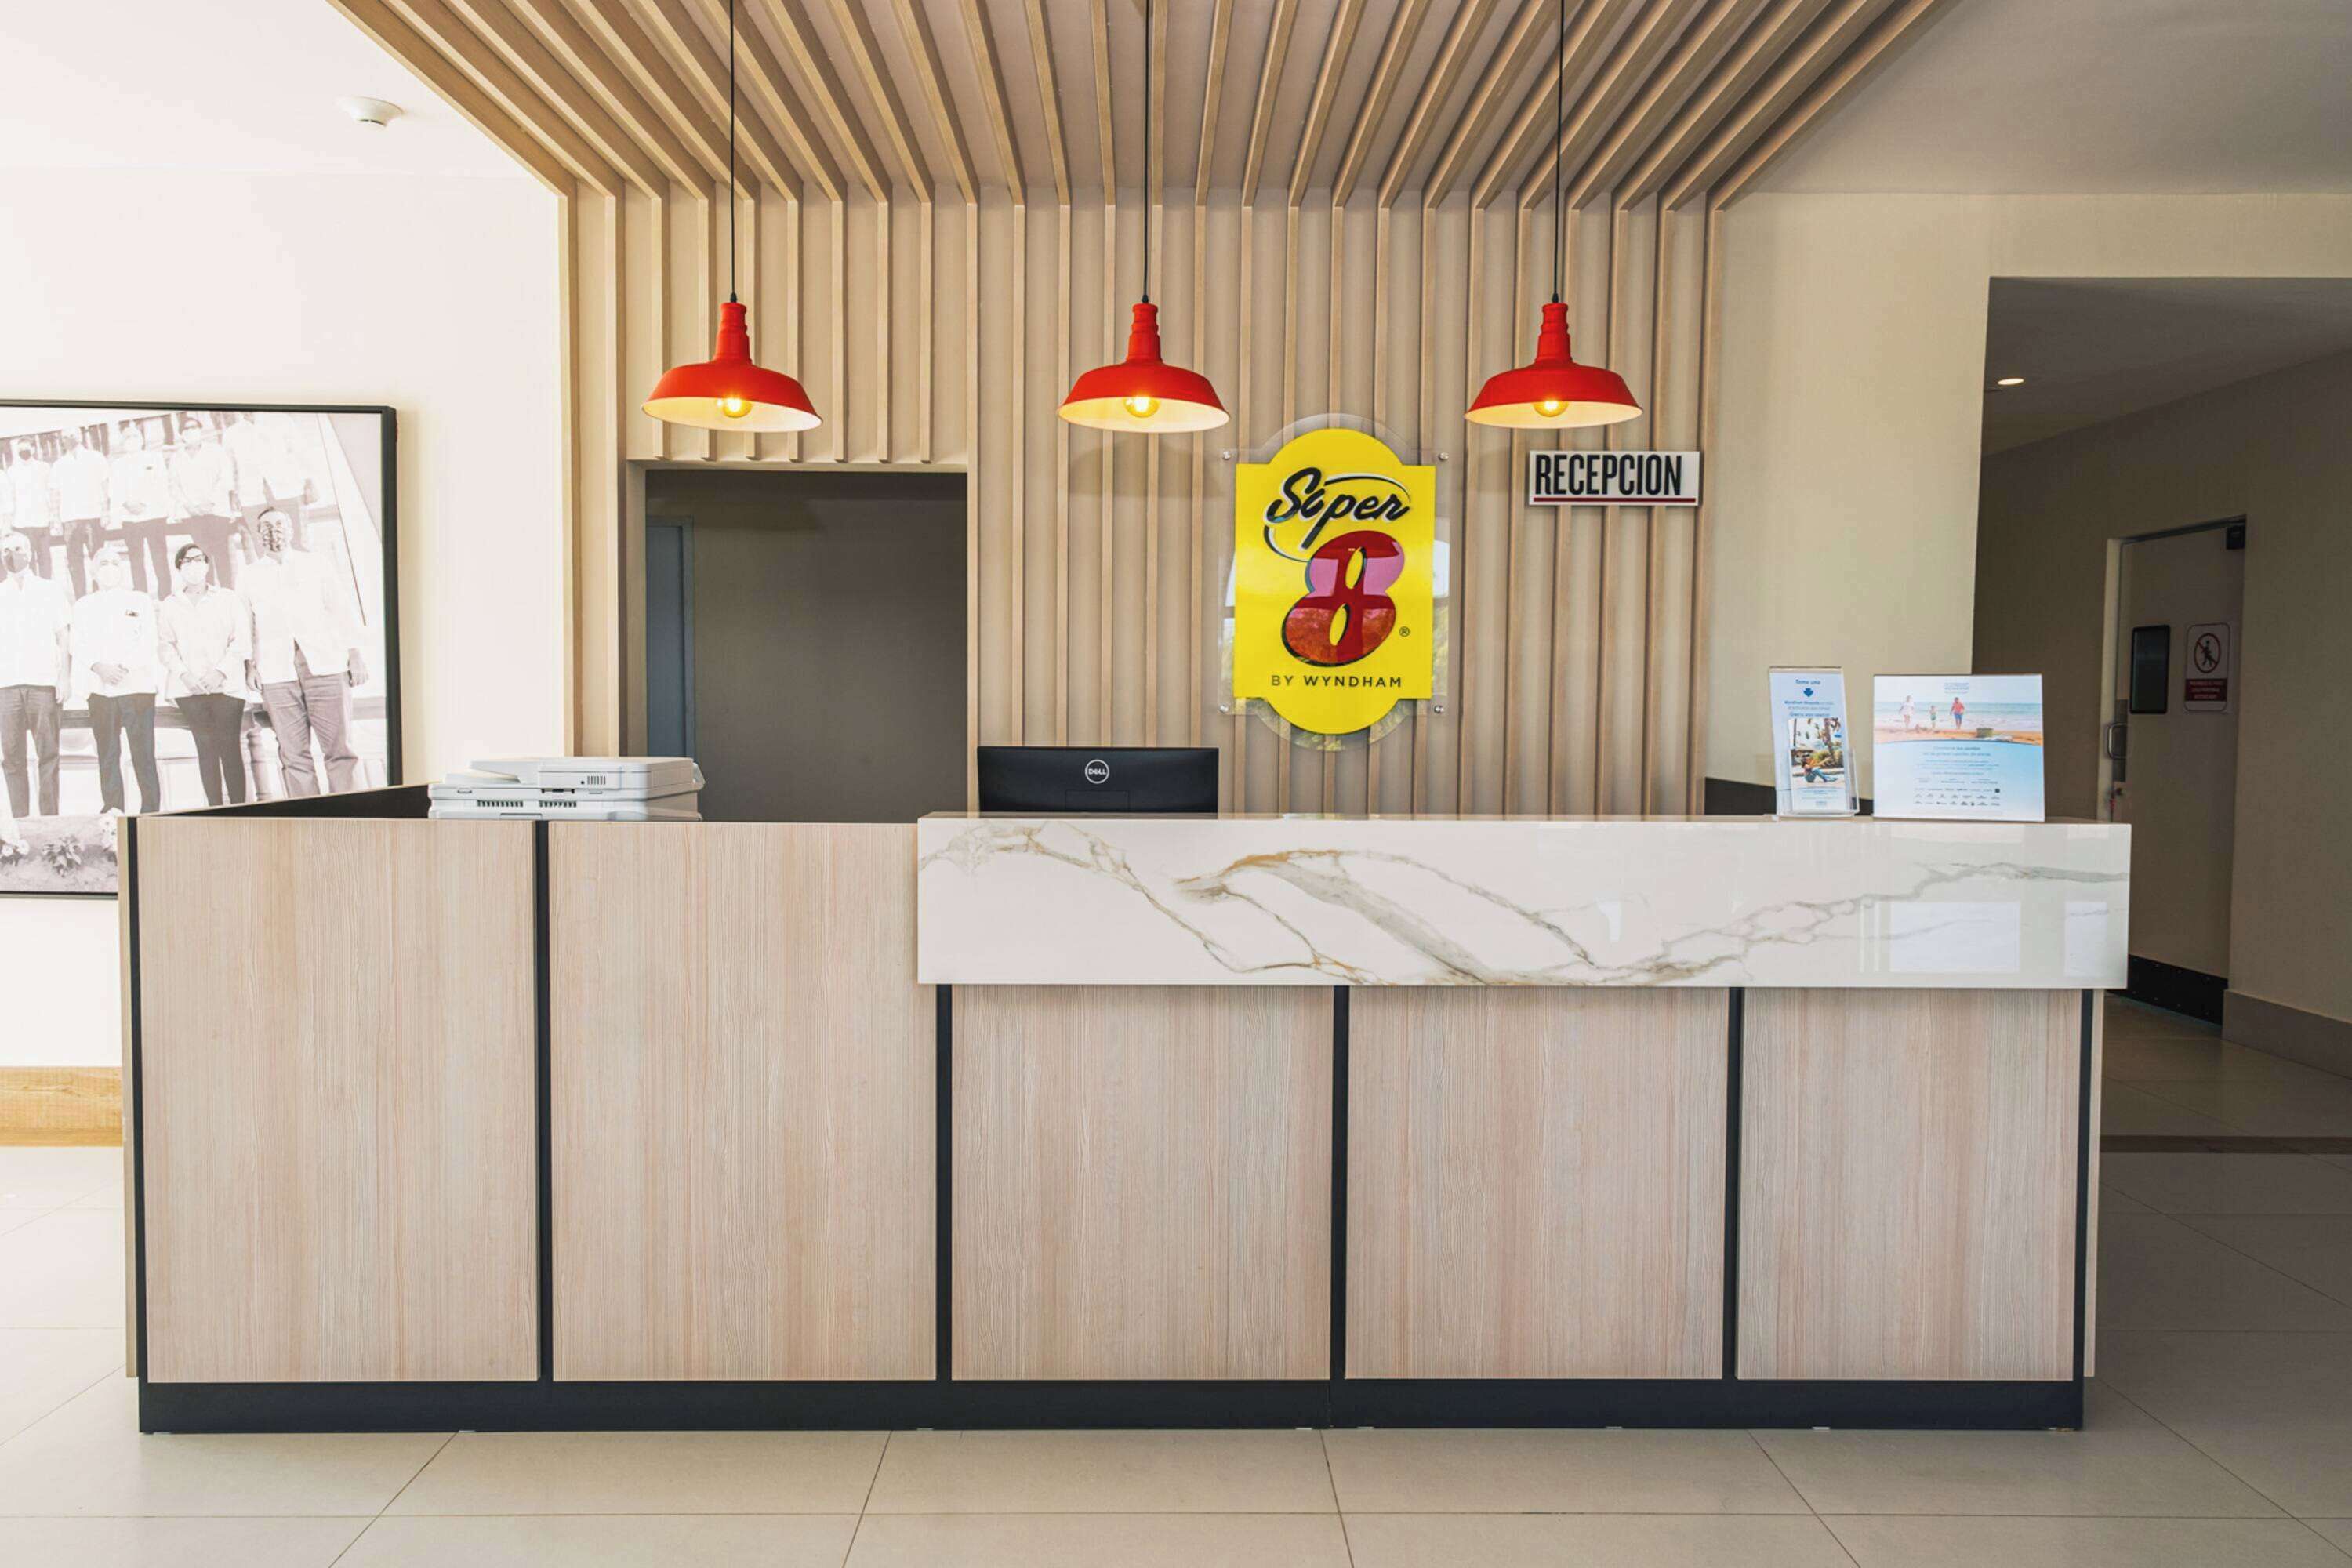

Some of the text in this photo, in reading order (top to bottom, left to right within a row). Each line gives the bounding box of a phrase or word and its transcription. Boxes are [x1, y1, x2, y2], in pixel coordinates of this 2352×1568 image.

[1535, 454, 1682, 495] RECEPCION
[1265, 466, 1410, 550] Super
[1281, 529, 1405, 667] 8
[1271, 675, 1402, 688] BY WYNDHAM
